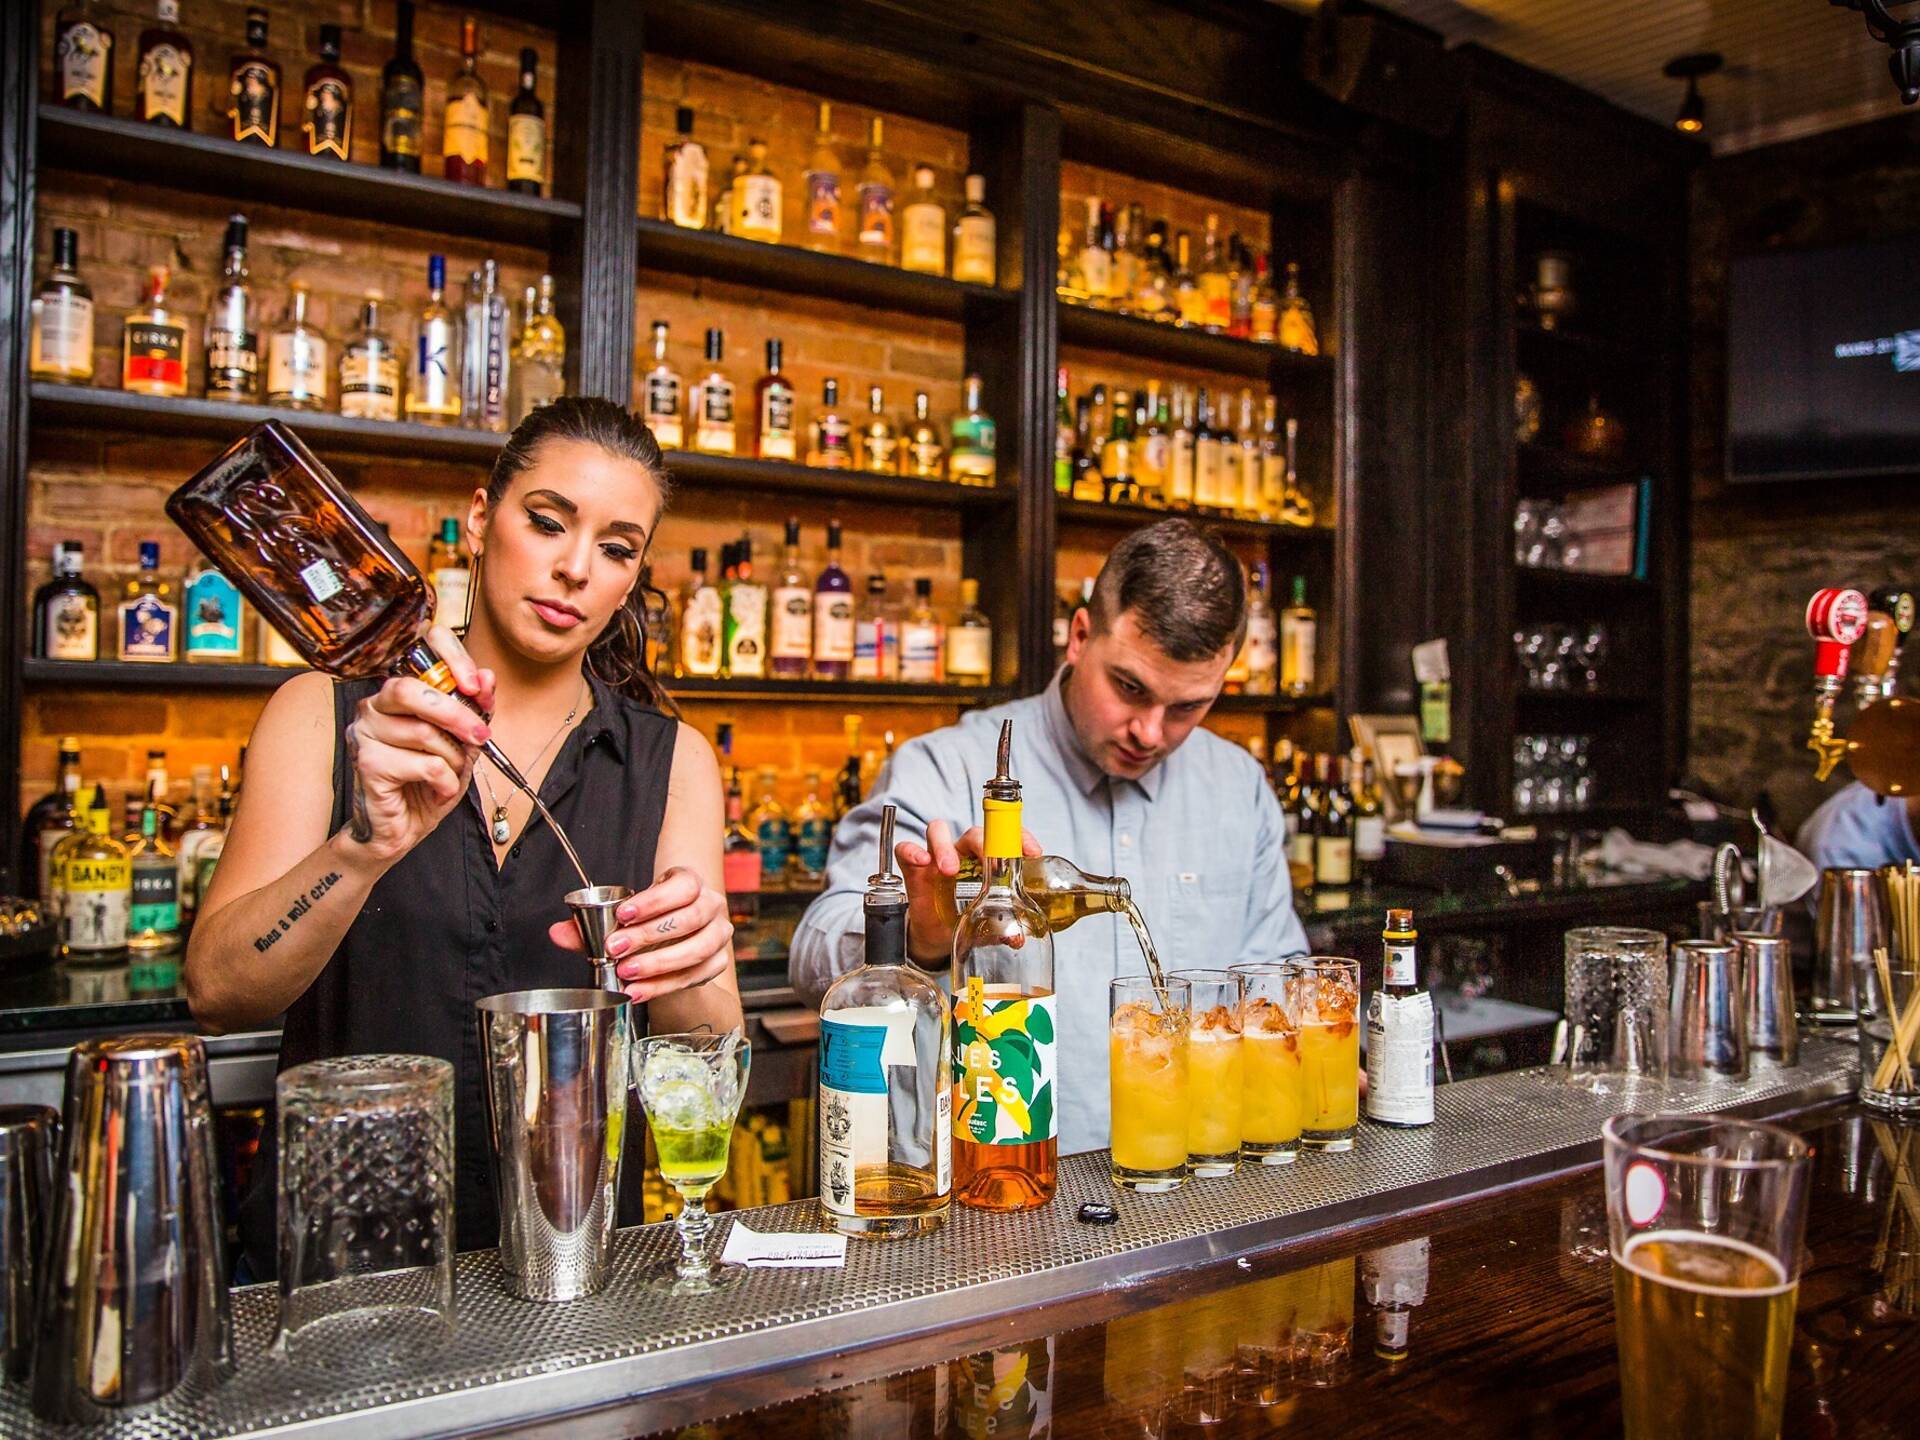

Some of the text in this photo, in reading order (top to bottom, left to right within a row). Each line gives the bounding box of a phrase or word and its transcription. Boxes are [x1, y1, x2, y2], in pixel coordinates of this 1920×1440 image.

[71, 864, 126, 882] DANDY
[134, 878, 174, 891] IRKA
[254, 928, 282, 953] When
[278, 919, 290, 931] a
[287, 894, 312, 922] wolf
